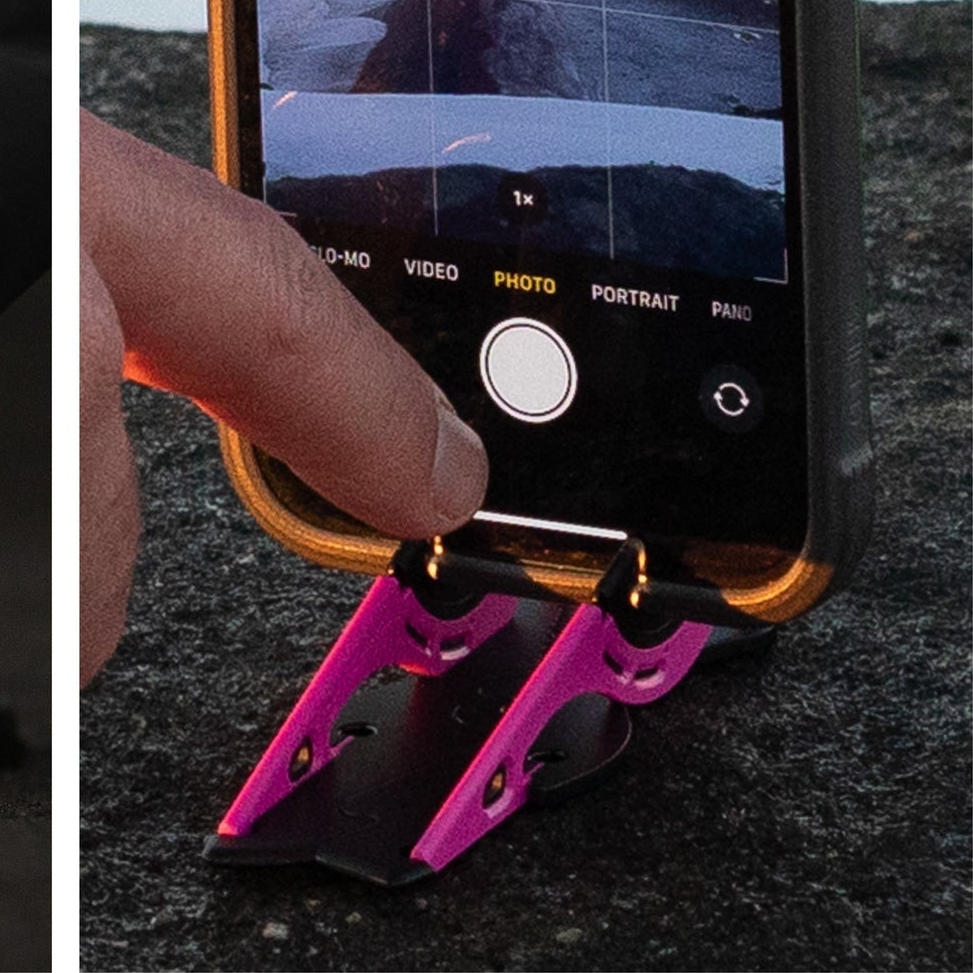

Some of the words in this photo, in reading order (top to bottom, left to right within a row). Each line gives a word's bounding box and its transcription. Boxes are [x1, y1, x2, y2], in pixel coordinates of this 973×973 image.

[309, 245, 371, 270] LO-MO
[403, 257, 459, 282] VIDEO
[493, 270, 557, 295] PHOTO
[591, 283, 680, 312] PORTRAIT
[711, 300, 753, 323] PANO
